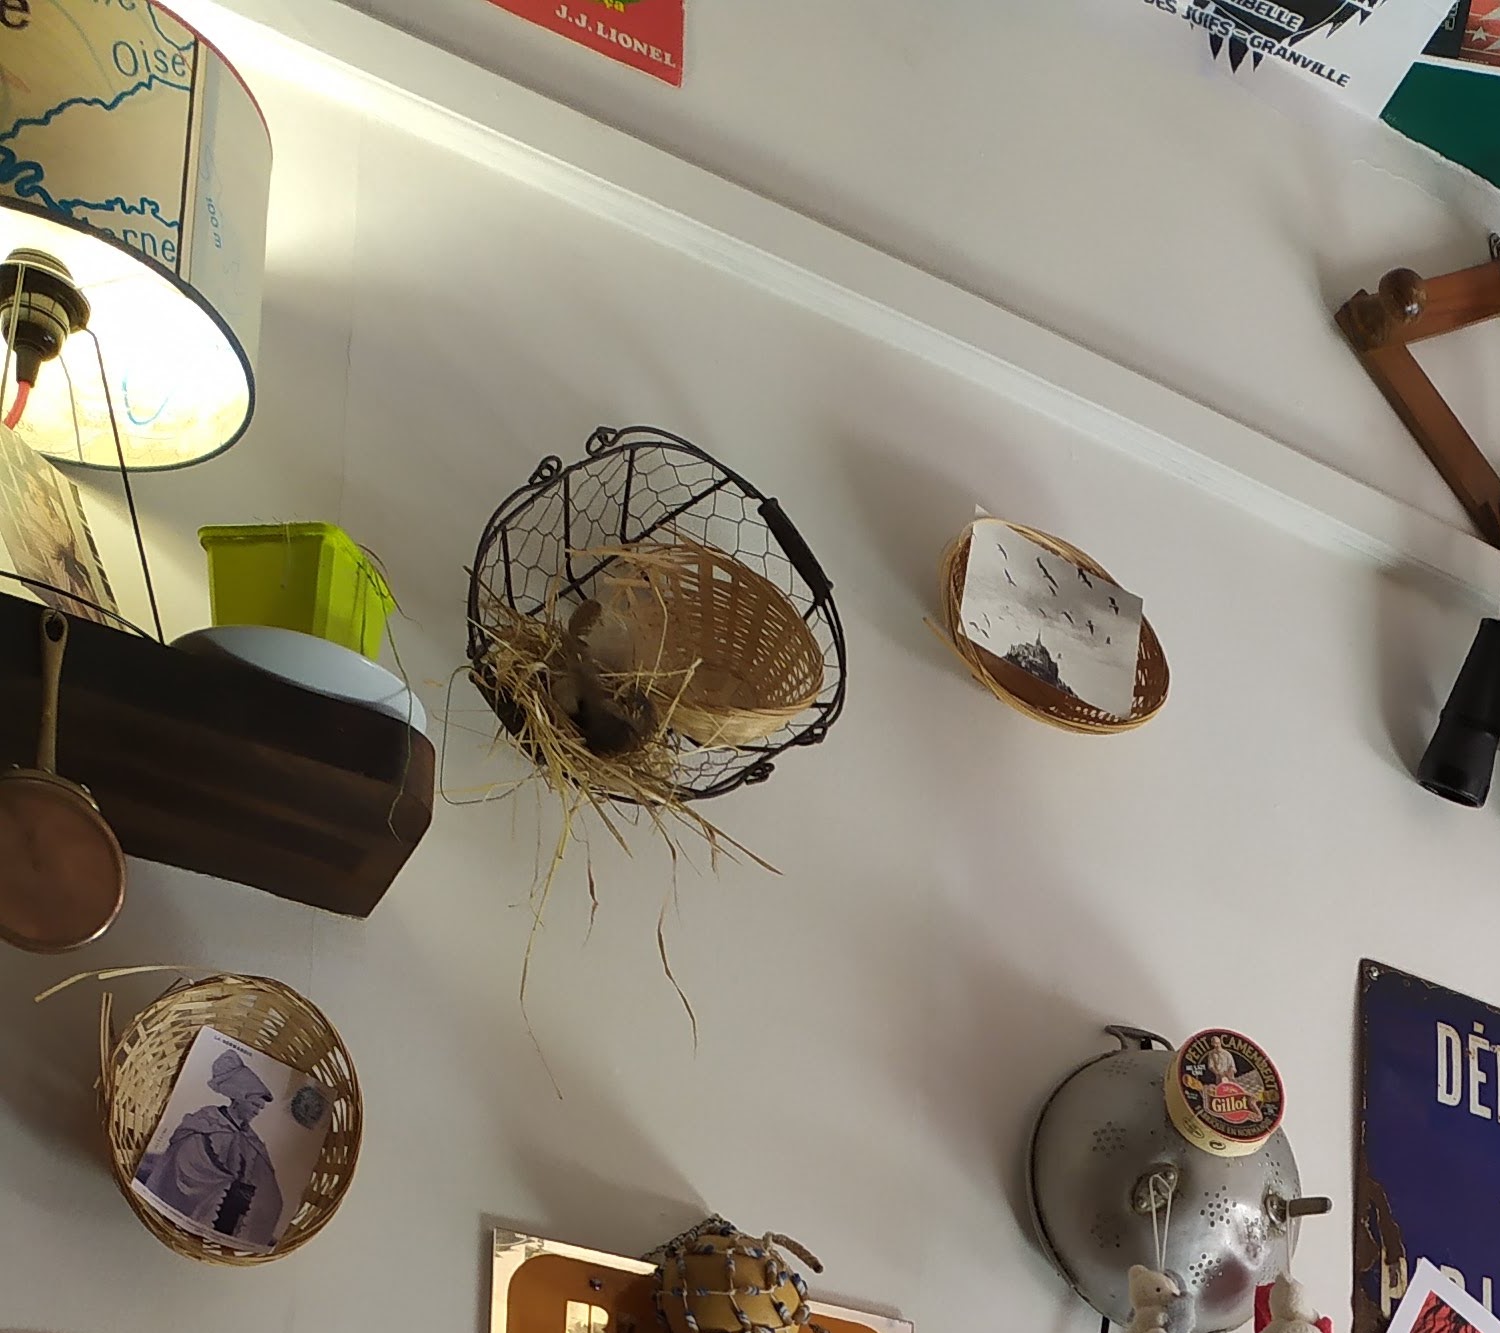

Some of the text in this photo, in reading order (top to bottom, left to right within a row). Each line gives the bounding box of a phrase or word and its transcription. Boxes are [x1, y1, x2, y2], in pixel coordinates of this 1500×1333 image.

[112, 41, 187, 77] Oise
[597, 21, 676, 68] LIONEL
[1249, 34, 1350, 88] GRANVILLE
[1184, 1034, 1279, 1091] PETIT CAMEMBERT
[1211, 1095, 1248, 1113] Gillot
